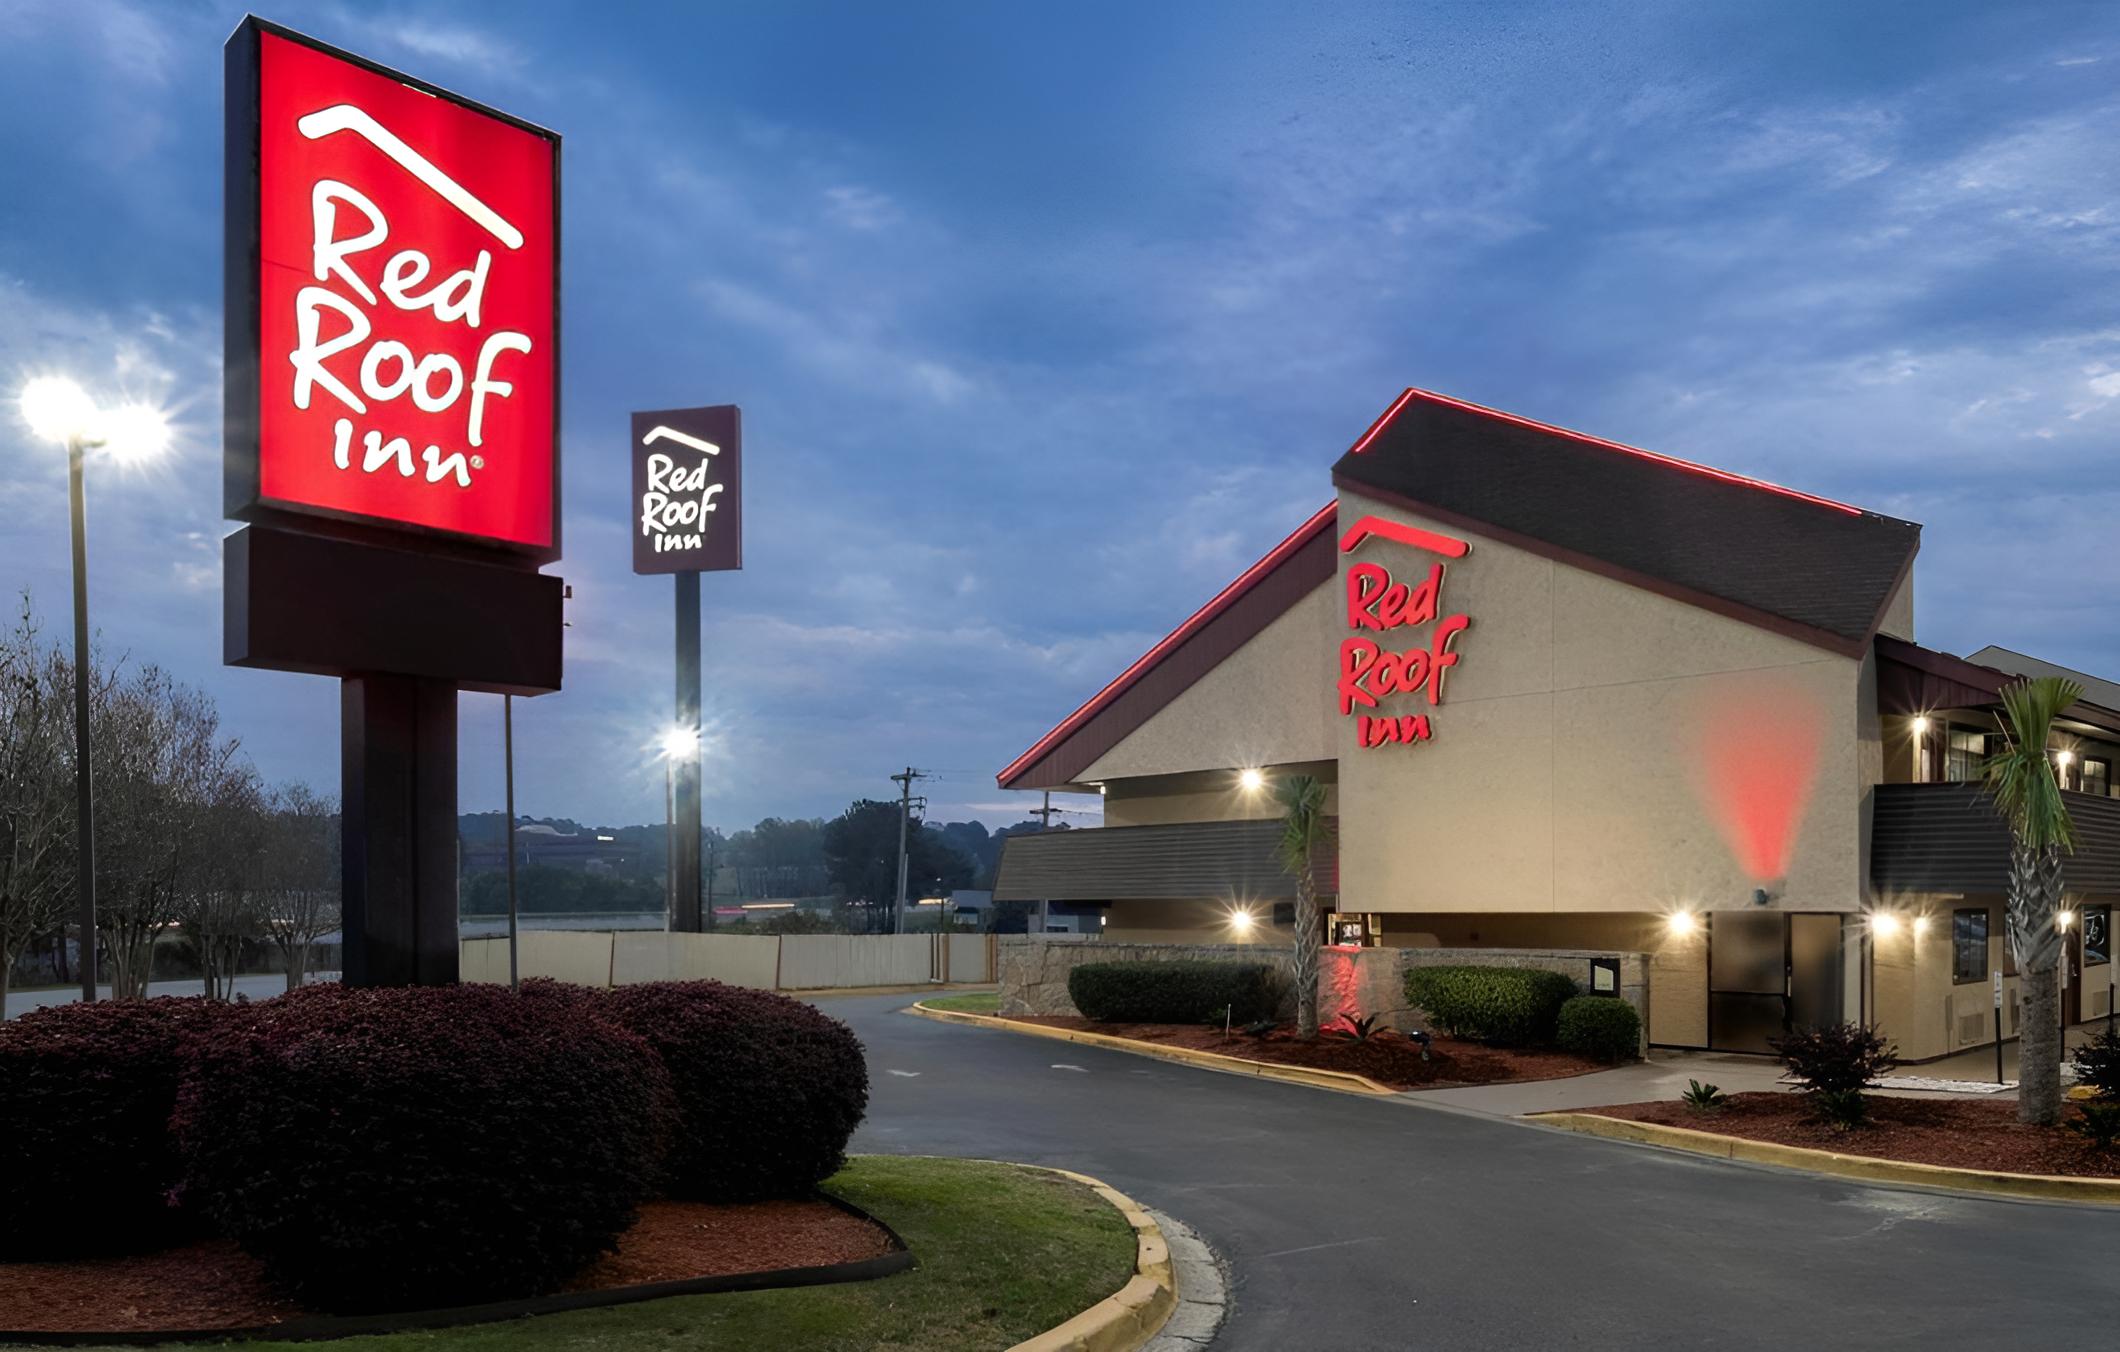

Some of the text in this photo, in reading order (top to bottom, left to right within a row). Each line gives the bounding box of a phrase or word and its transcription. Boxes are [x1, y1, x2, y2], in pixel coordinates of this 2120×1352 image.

[312, 179, 491, 328] Red
[289, 286, 532, 446] Roof
[641, 483, 724, 536] Roof
[648, 453, 708, 494] Red
[1347, 562, 1444, 631] Red
[1338, 614, 1470, 715] Roof
